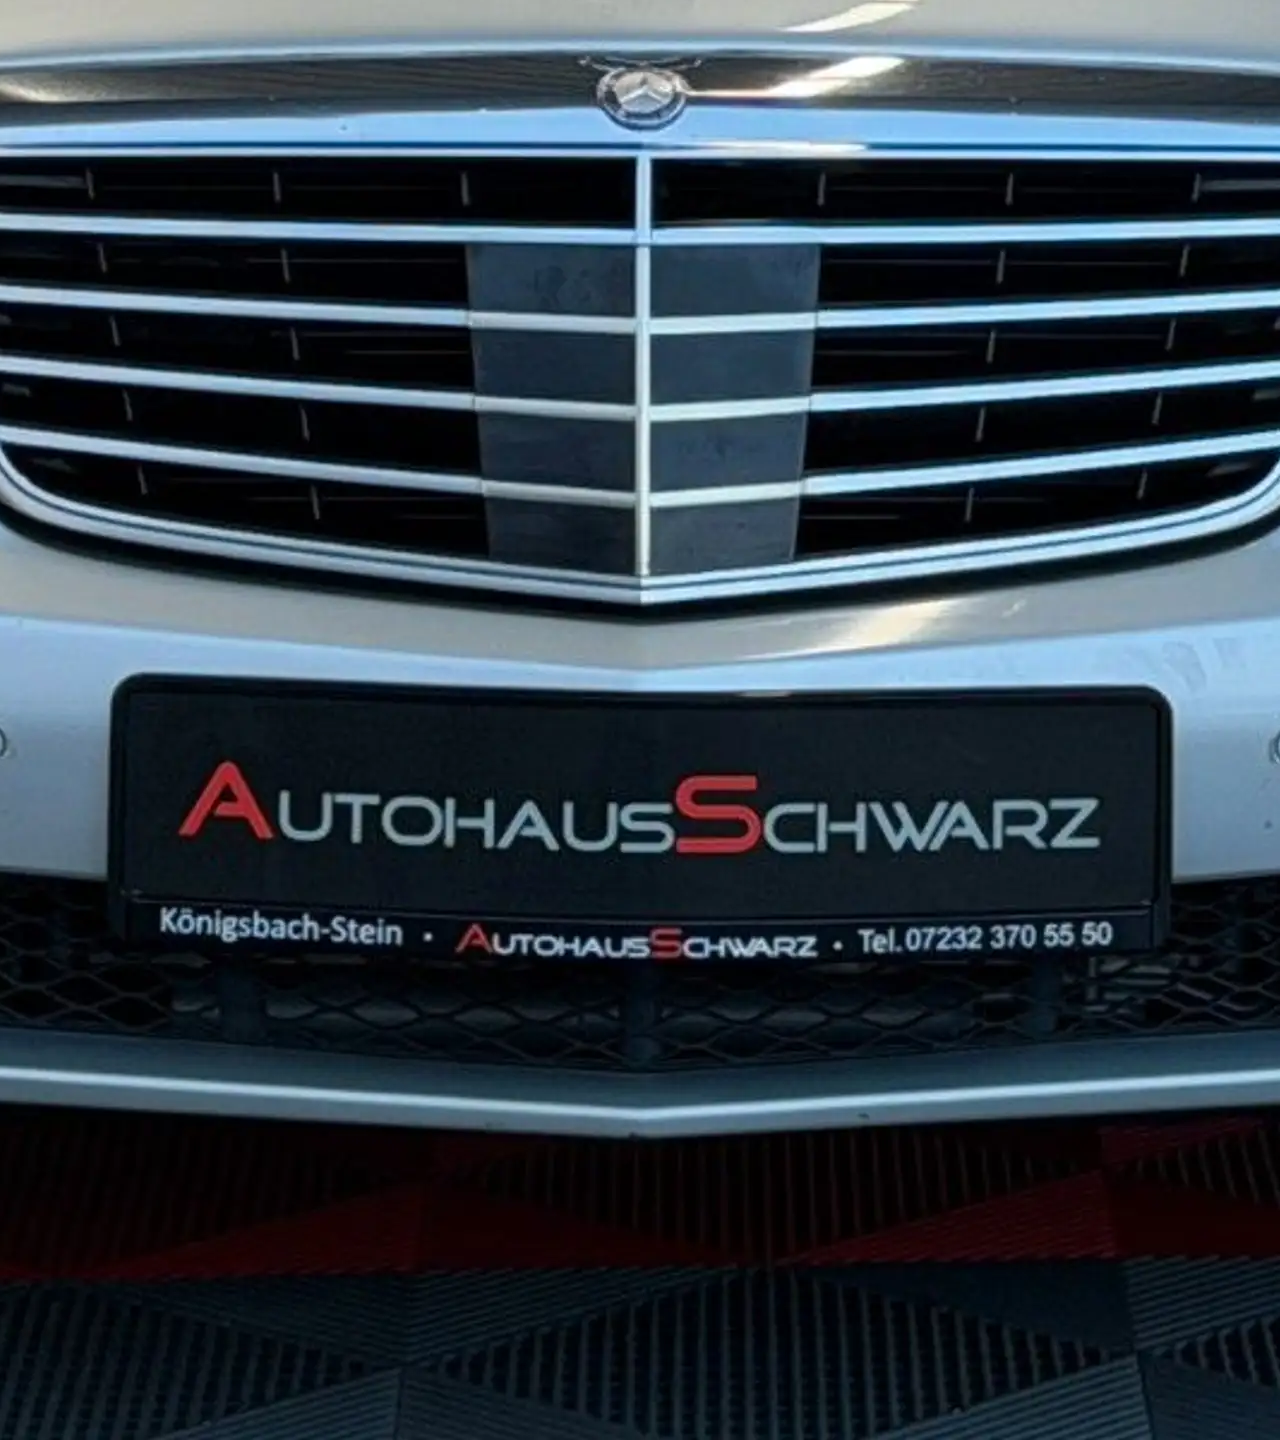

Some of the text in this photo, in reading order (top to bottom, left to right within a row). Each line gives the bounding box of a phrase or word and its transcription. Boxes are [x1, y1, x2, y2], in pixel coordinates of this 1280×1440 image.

[159, 907, 404, 945] Königsbach-Stein
[857, 927, 903, 954] Tel.
[905, 924, 983, 951] 07232
[990, 923, 1037, 949] 370
[1043, 922, 1075, 948] 55
[1081, 921, 1113, 946] 50
